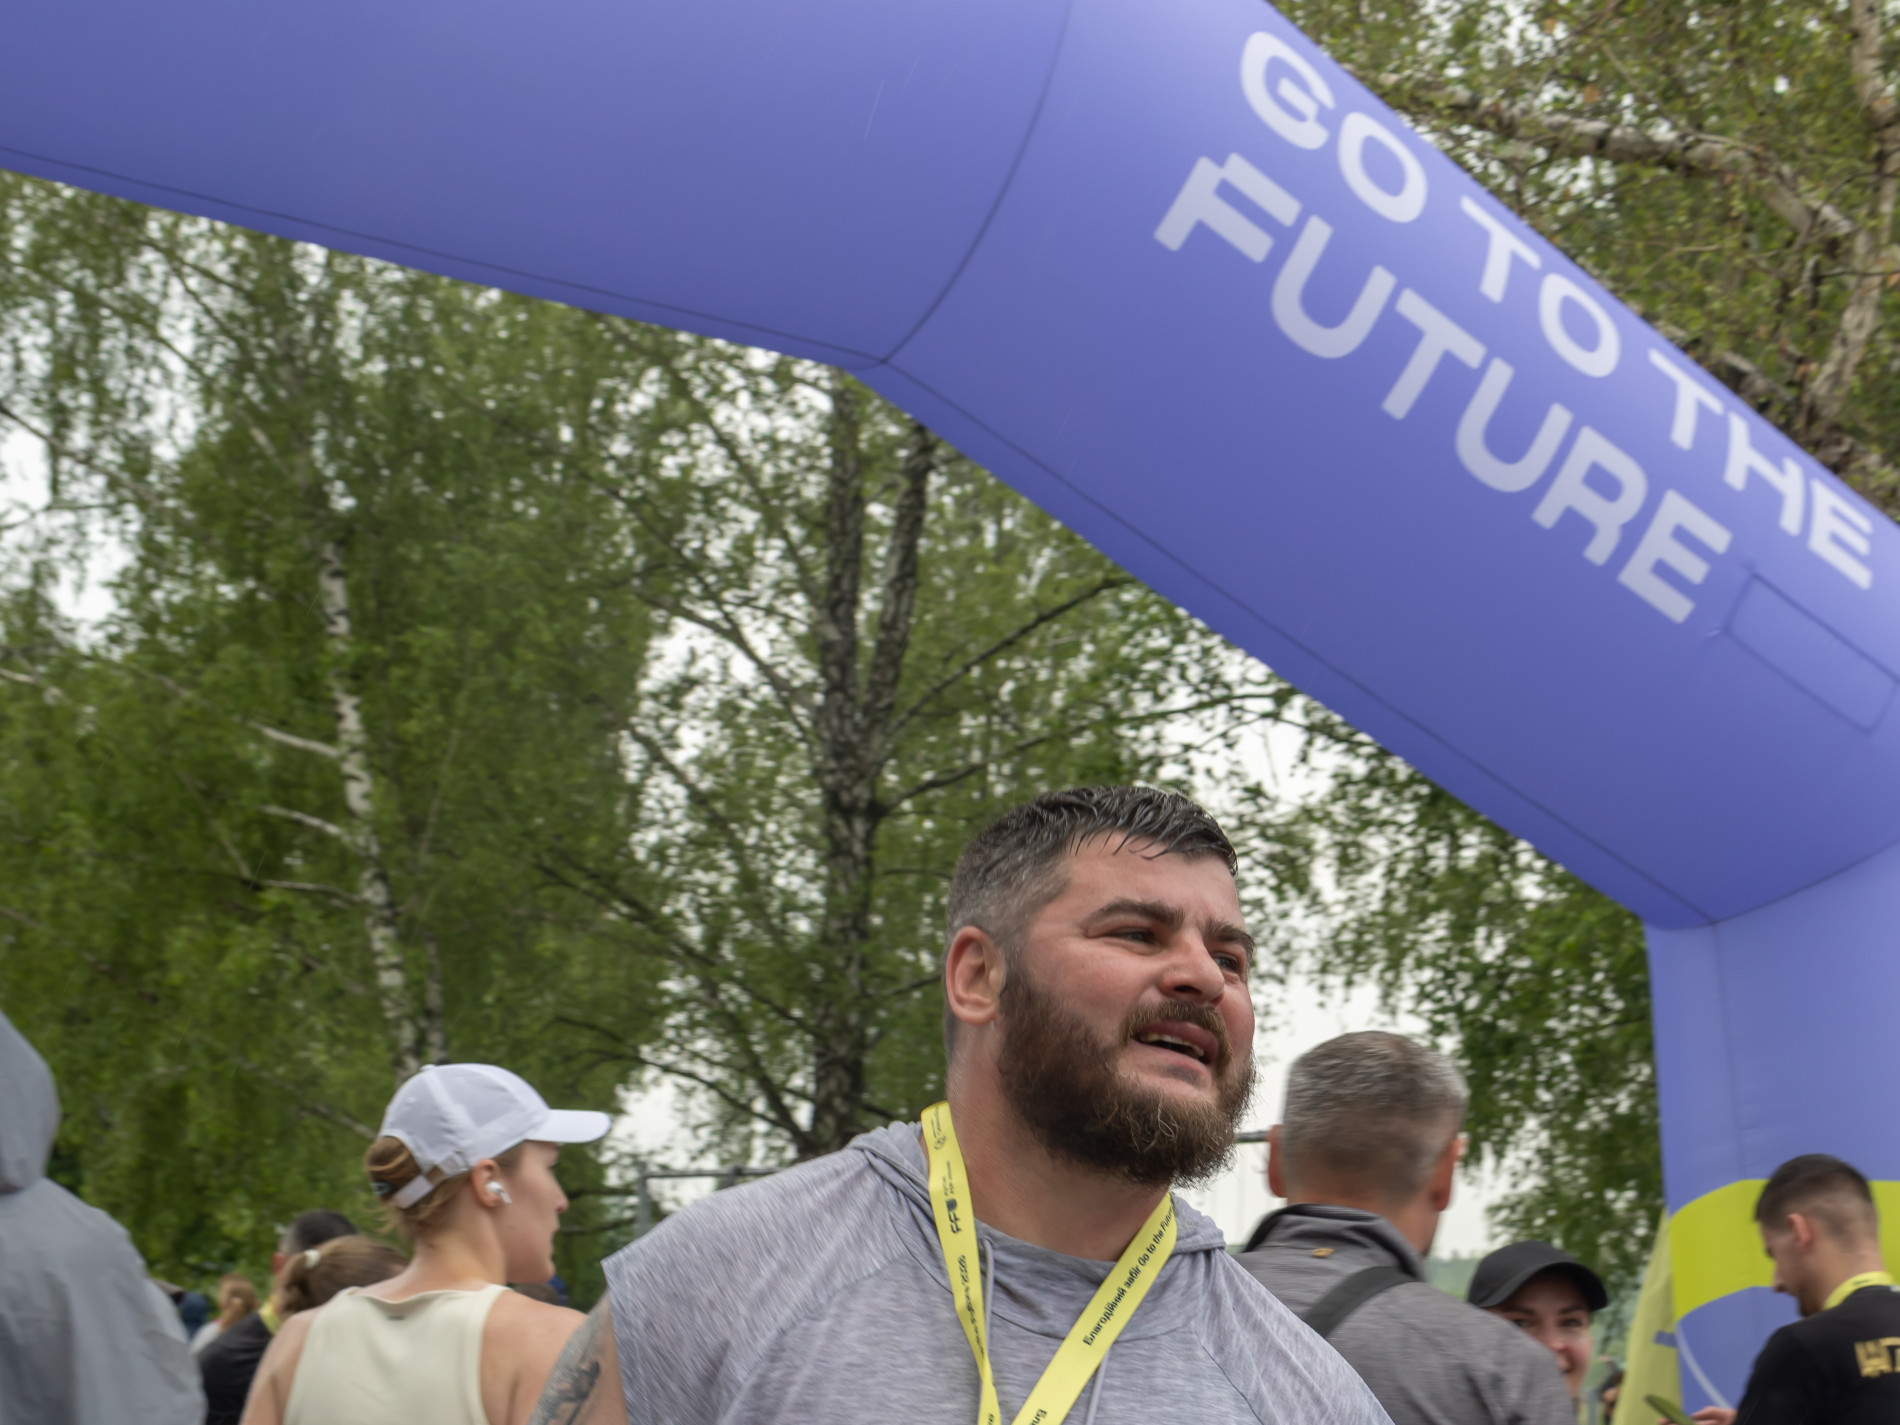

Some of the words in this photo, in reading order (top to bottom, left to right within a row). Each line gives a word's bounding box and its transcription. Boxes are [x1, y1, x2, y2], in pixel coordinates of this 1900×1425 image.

[1152, 151, 1734, 625] FUTURE
[1239, 30, 1429, 224] GO
[1459, 195, 1621, 379] TO
[1648, 348, 1874, 592] THE
[1083, 1287, 1127, 1346] Благодійний
[1138, 1253, 1150, 1267] Go
[1146, 1243, 1156, 1254] to
[1153, 1232, 1164, 1245] the
